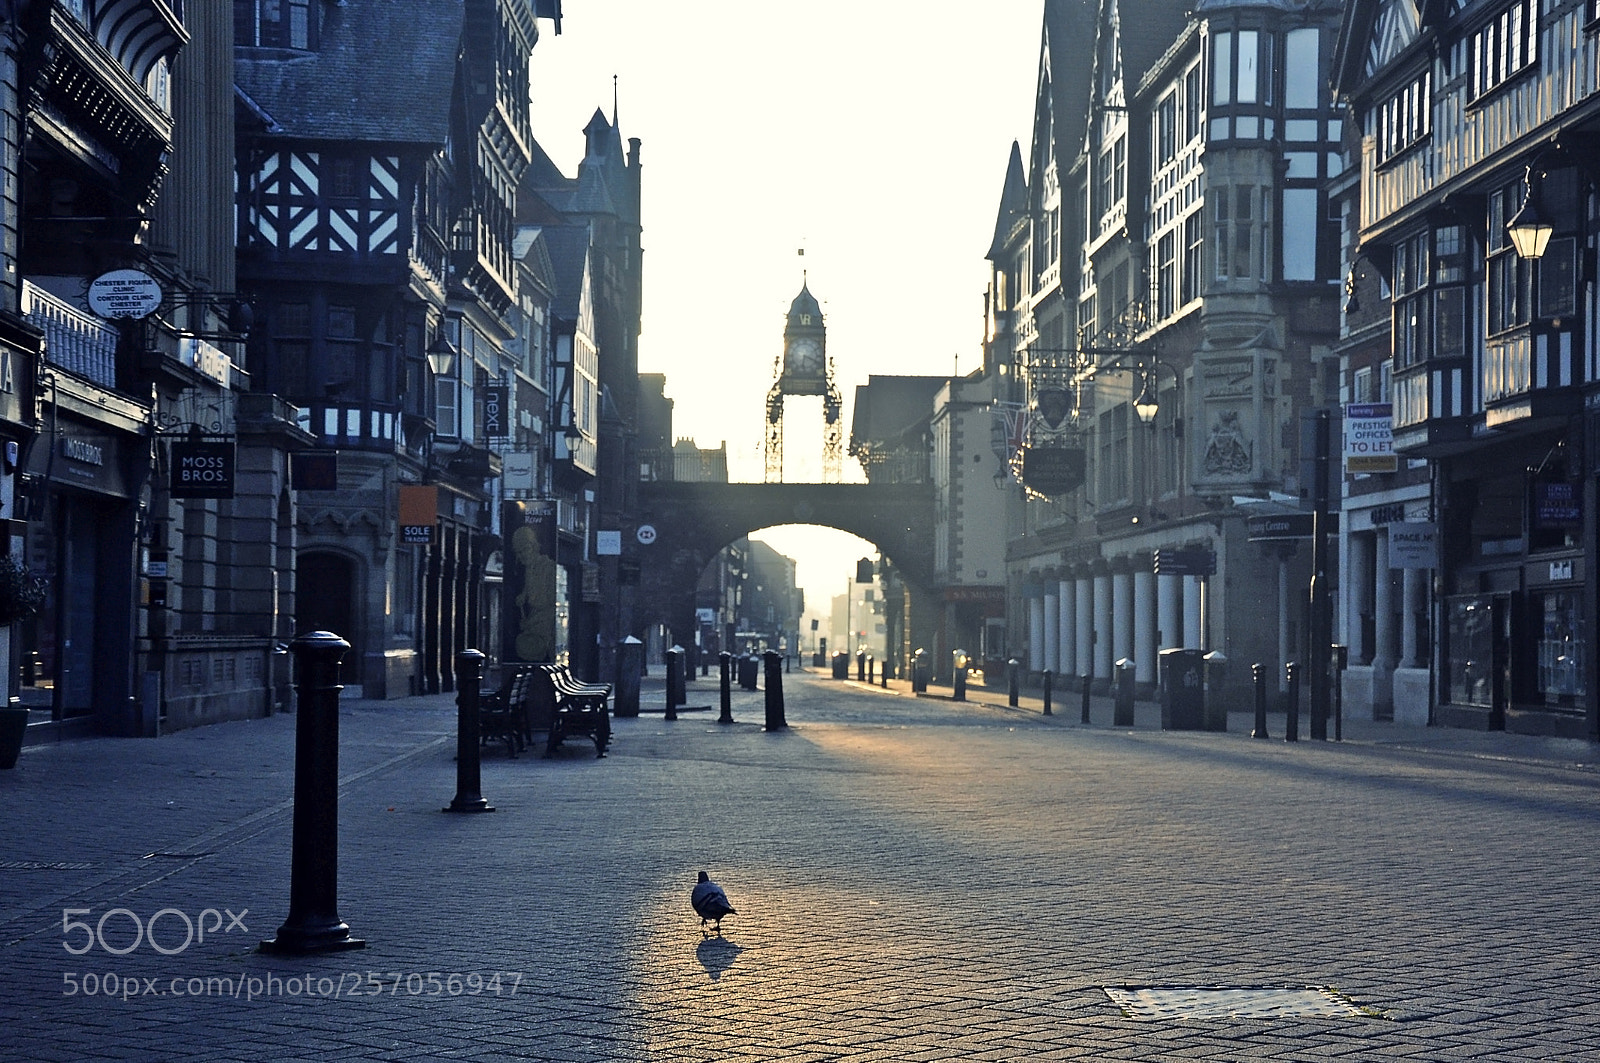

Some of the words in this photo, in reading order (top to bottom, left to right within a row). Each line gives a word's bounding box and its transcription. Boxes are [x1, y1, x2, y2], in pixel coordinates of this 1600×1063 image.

[486, 392, 499, 431] next
[1352, 421, 1391, 430] PRESTIGE
[1355, 431, 1390, 439] OFFICES
[1350, 441, 1368, 453] TO
[1372, 441, 1393, 452] LET
[182, 457, 224, 468] MOSS
[182, 470, 228, 481] BROS.
[404, 526, 431, 535] SOLE
[1393, 534, 1420, 542] SPACE
